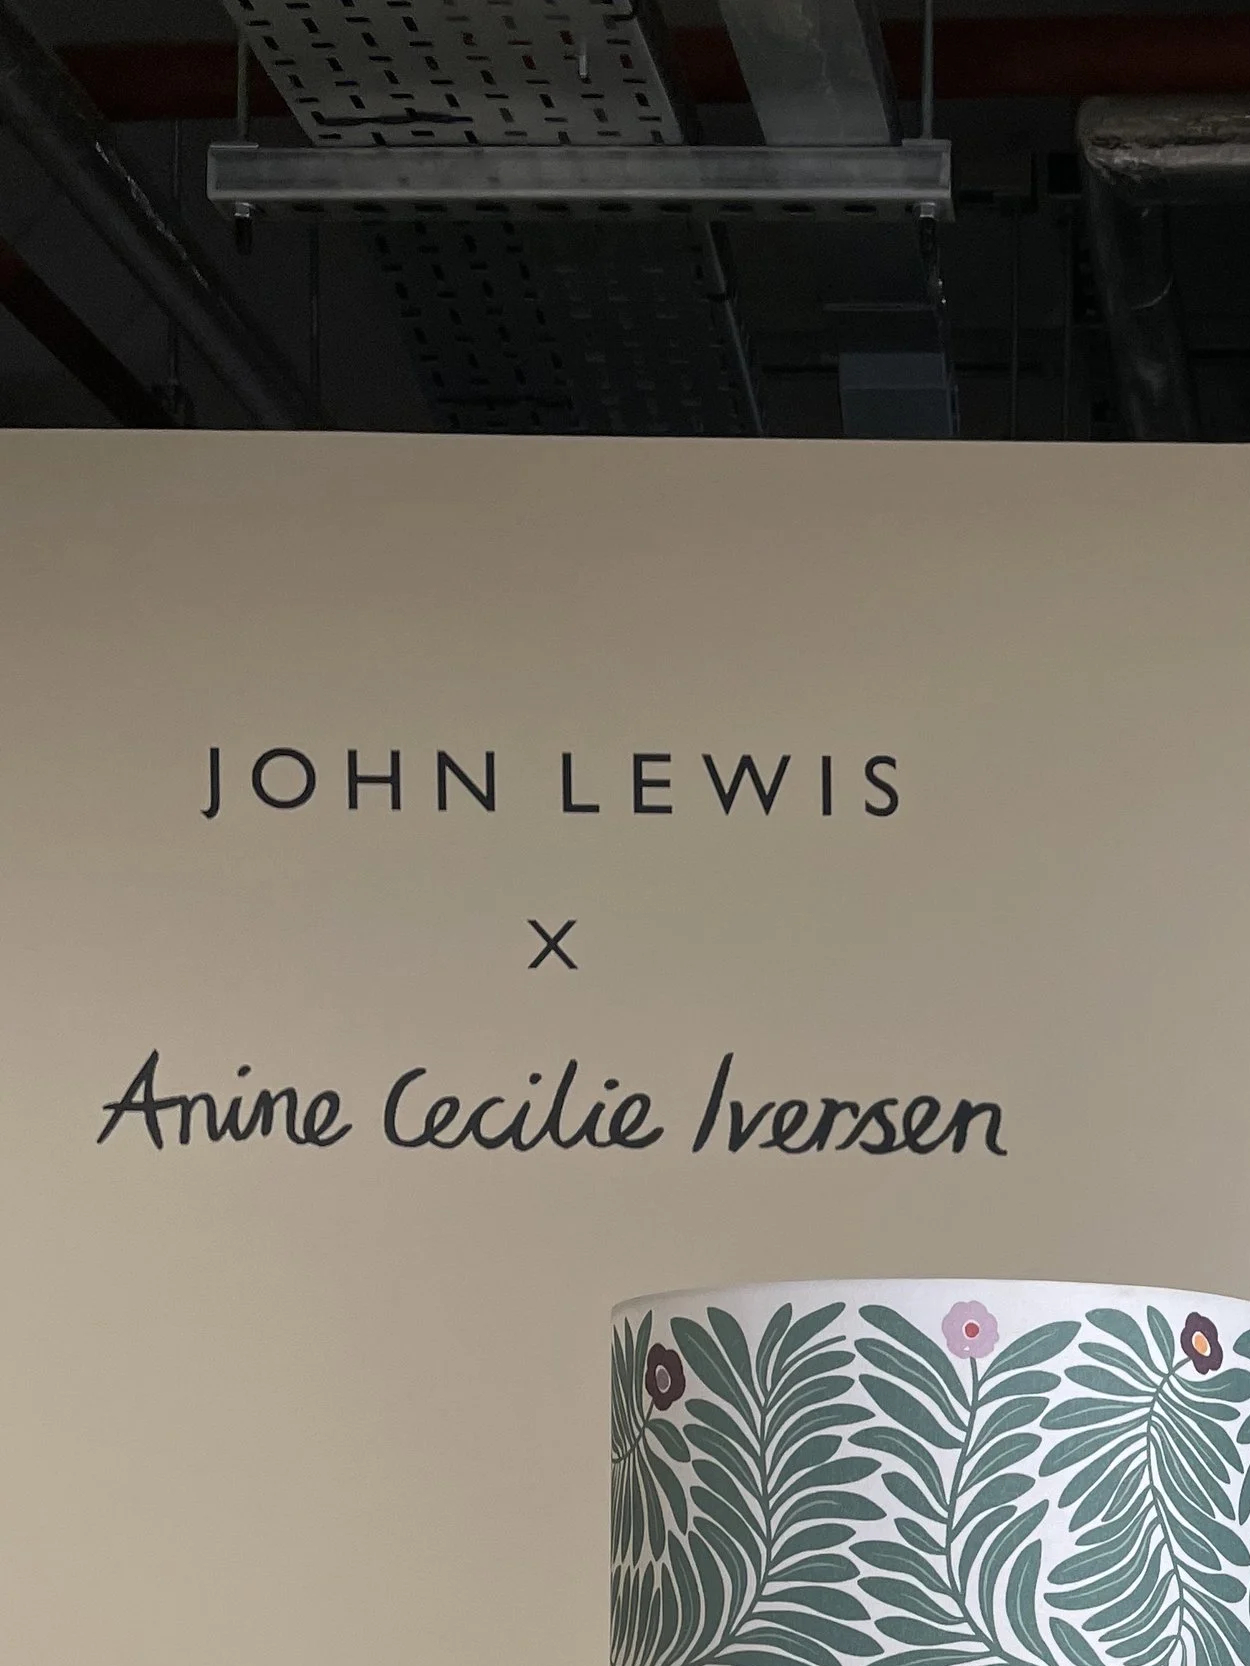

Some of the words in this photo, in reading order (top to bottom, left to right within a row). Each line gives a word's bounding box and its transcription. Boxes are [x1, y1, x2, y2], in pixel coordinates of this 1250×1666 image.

[201, 747, 496, 820] JOHN
[561, 752, 899, 817] LEWIS
[96, 1048, 353, 1151] Anine
[383, 1058, 665, 1153] Cecilie
[691, 1051, 1008, 1157] Iversen
